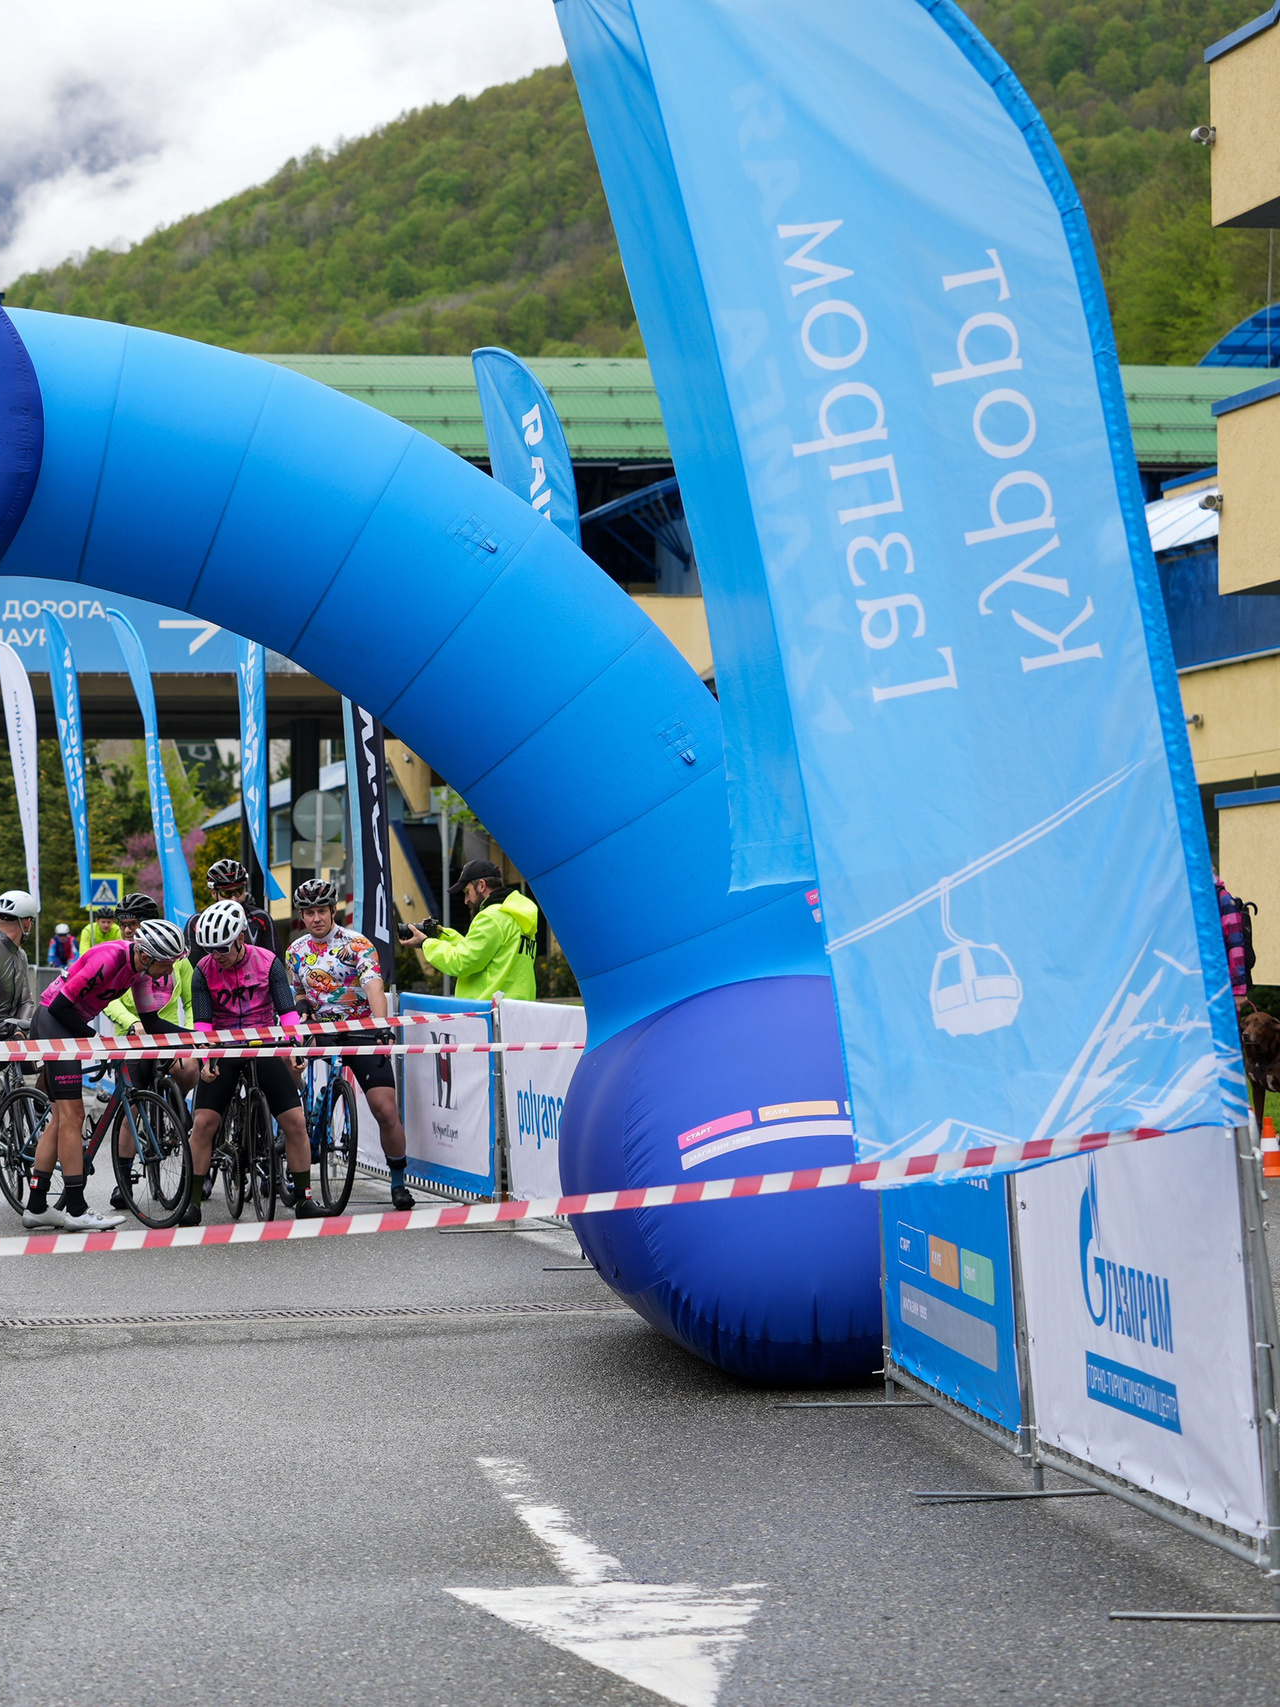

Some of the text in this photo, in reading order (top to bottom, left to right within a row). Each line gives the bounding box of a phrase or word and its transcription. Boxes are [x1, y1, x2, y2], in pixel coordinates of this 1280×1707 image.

[217, 983, 262, 1007] DRT
[517, 1079, 565, 1150] polyana
[685, 1126, 712, 1142] СТАРТ
[1106, 1260, 1174, 1354] ГАЗПРОМ
